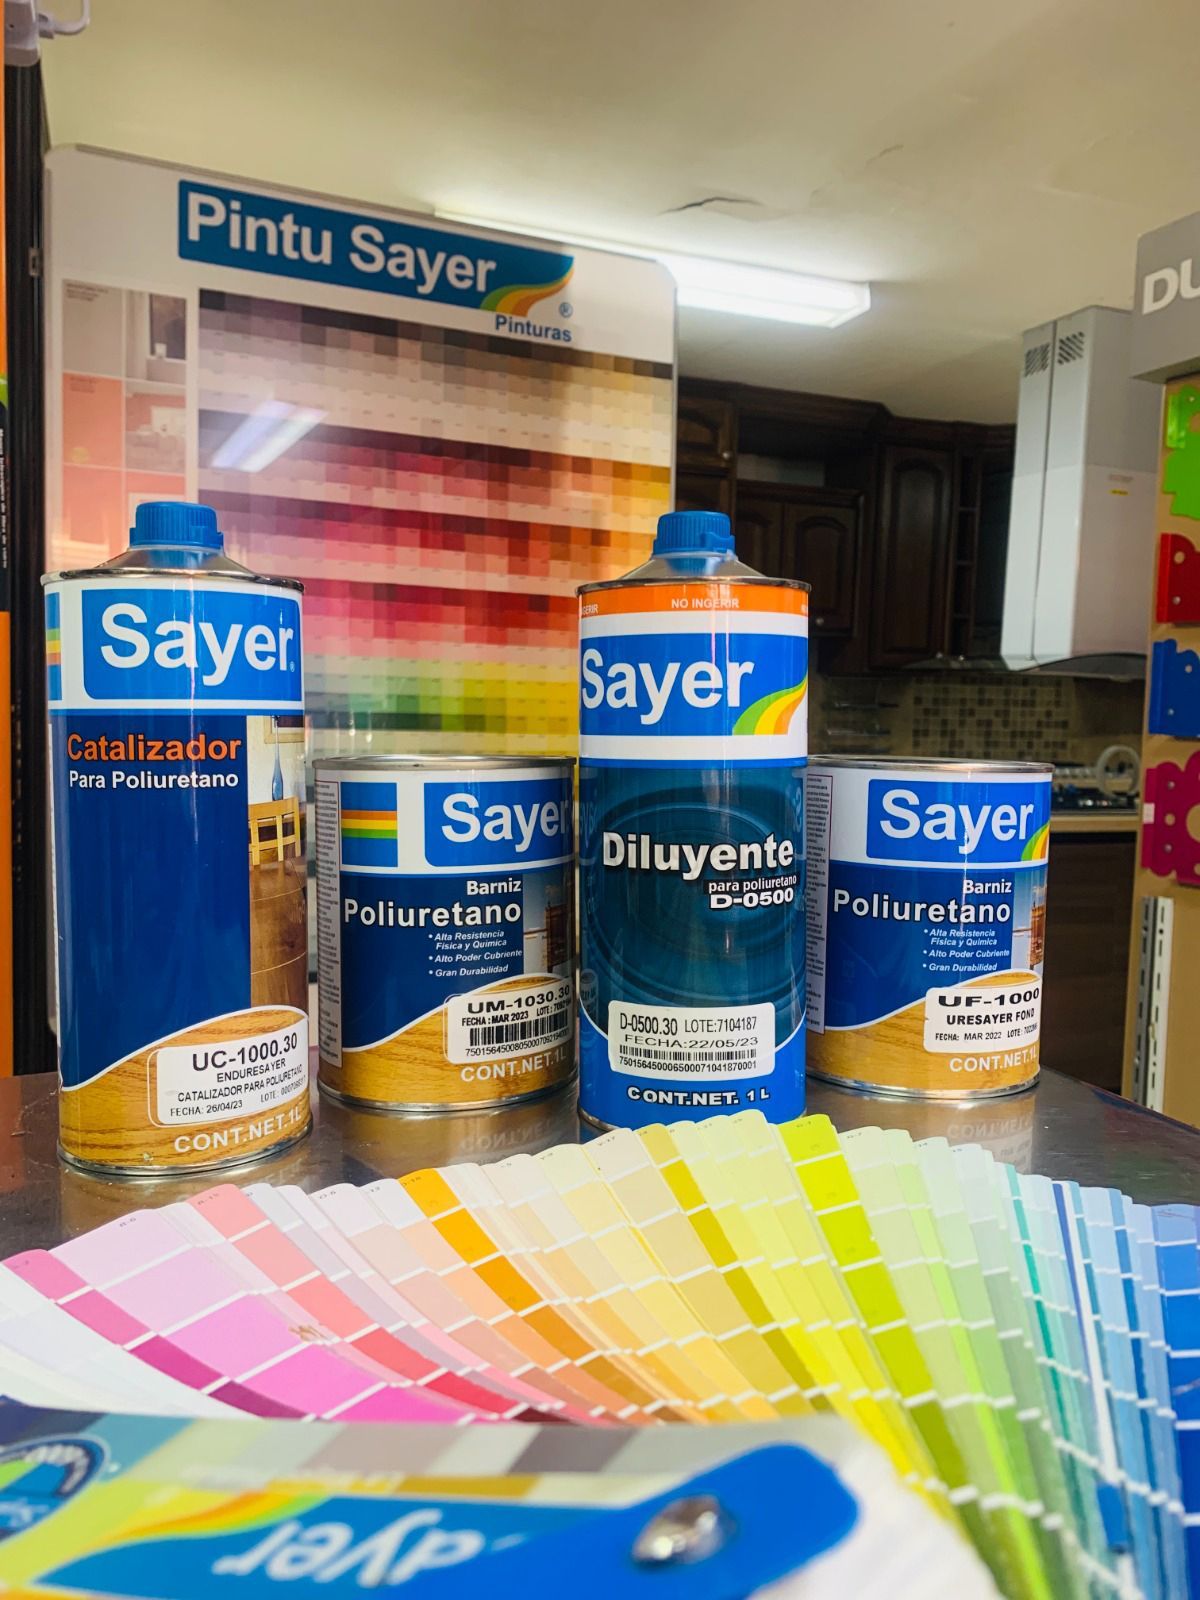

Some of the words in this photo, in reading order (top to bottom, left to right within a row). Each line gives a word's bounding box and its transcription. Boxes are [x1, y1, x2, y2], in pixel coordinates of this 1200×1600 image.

[187, 190, 332, 265] Pintu
[349, 224, 497, 296] Sayer
[494, 314, 573, 343] Pinturas
[671, 598, 689, 609] NO
[691, 598, 740, 609] INGERIR
[100, 602, 294, 687] Sayer
[582, 648, 755, 725] Sayer
[67, 732, 242, 761] Catalizador
[69, 769, 106, 788] Para
[112, 770, 240, 788] Poliuretano
[441, 792, 569, 853] Sayer
[879, 788, 1035, 855] Sayer
[602, 831, 795, 881] Diluyente
[466, 877, 522, 896] Barniz
[708, 881, 740, 894] para
[743, 875, 797, 893] poliuretano
[963, 878, 1012, 894] Barniz
[710, 887, 794, 909] D-0500
[833, 888, 1011, 924] Poliuretano
[344, 898, 522, 928] Poliuretano
[434, 933, 453, 941] Alta
[454, 930, 505, 941] Resistencia
[929, 929, 948, 937] Alta
[949, 929, 996, 937] Resistencia
[464, 943, 471, 951] y
[958, 939, 964, 948] y
[434, 954, 454, 963] Alto
[455, 953, 482, 962] Poder
[483, 949, 523, 960] Cubriente
[928, 949, 947, 958] Alto
[949, 950, 974, 958] Poder
[975, 949, 1010, 958] Cubriente
[435, 968, 458, 977] Gran
[459, 964, 509, 976] Durabilidad
[929, 963, 950, 971] Gran
[952, 962, 998, 972] Durabilidad
[467, 985, 570, 1014] UM-1030.30
[938, 987, 1040, 1008] UF-1000
[511, 1010, 529, 1021] 2023
[619, 1012, 678, 1036] D-0500.30
[684, 1016, 757, 1034] LOTE:7104187
[946, 1012, 1013, 1026] URESAYER
[624, 1033, 759, 1049] FECHA:22/05/23
[935, 1032, 960, 1041] FECHA:
[964, 1032, 983, 1041] MAR
[985, 1031, 1002, 1040] 2022
[192, 1032, 298, 1072] UC-1000.30
[177, 1085, 243, 1103] CATALIZADOR
[244, 1080, 265, 1094] PARA
[170, 1105, 204, 1117] FECHA:
[206, 1099, 243, 1114] 26/04/23
[211, 1507, 528, 1589] ayer
